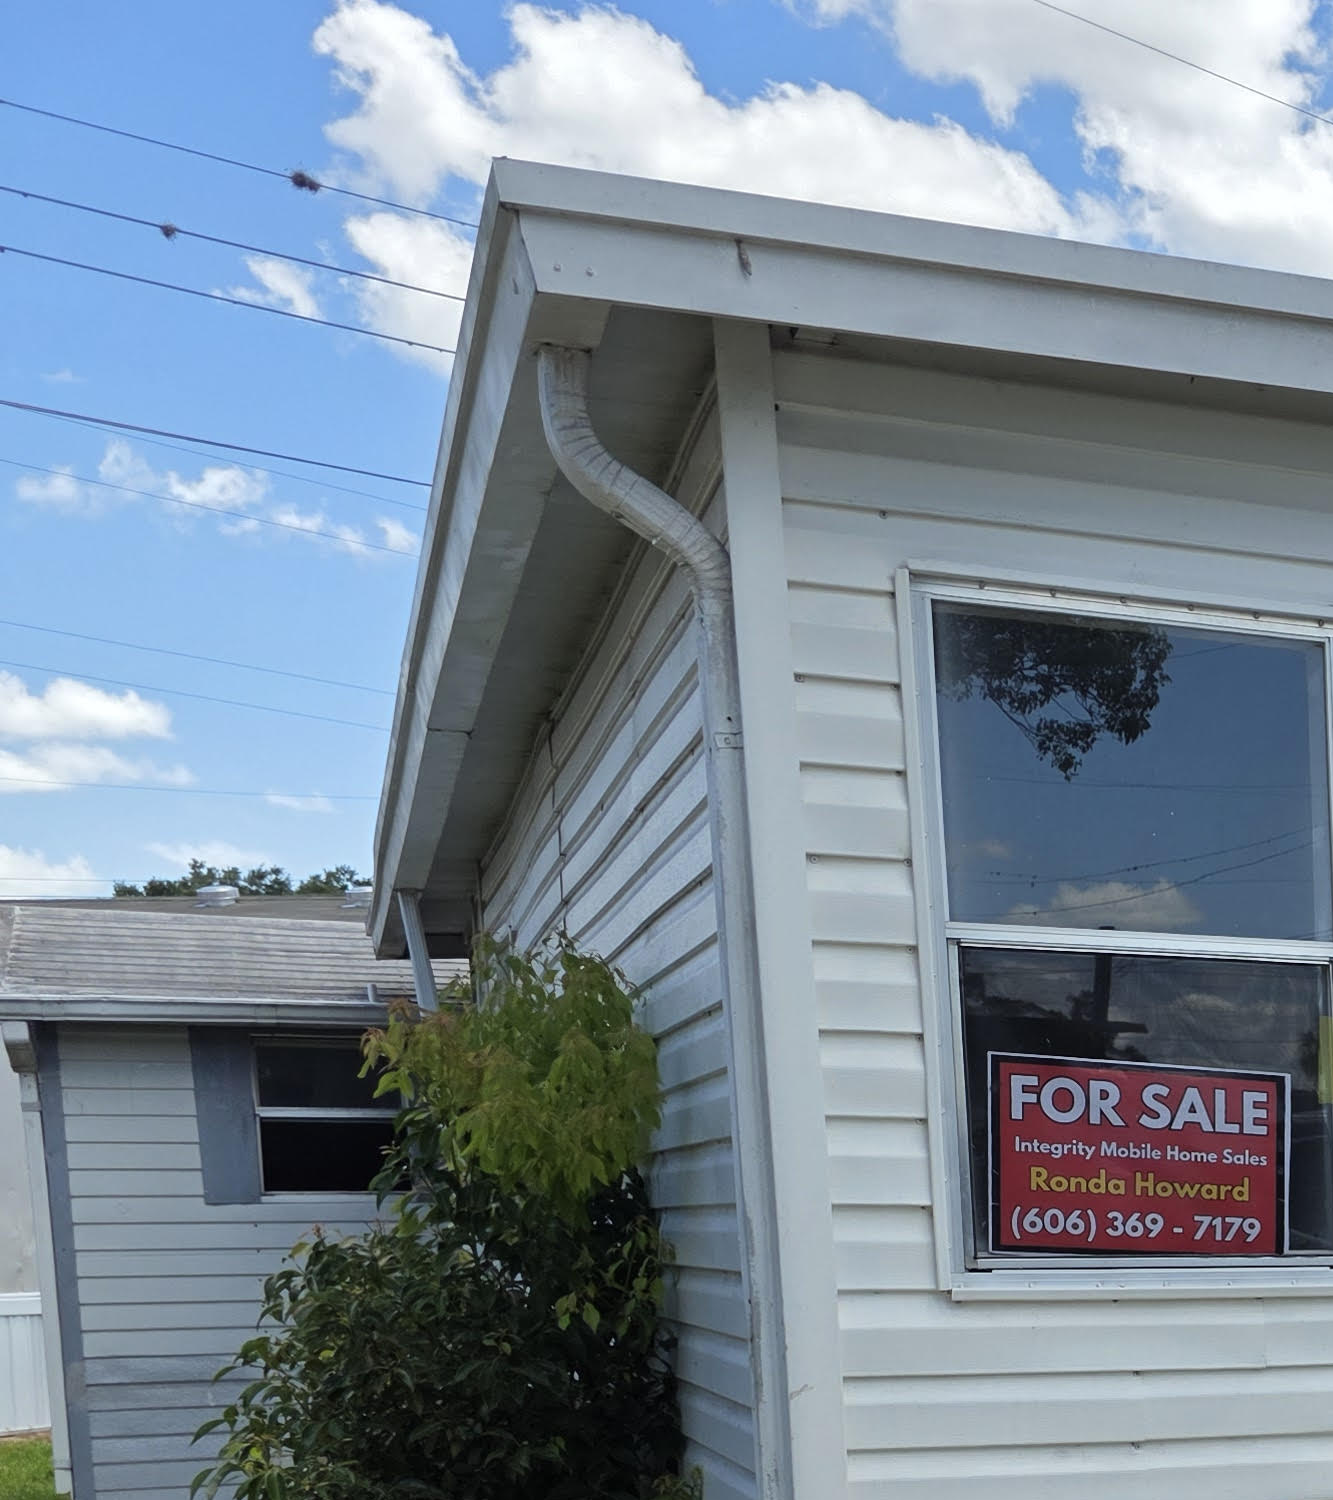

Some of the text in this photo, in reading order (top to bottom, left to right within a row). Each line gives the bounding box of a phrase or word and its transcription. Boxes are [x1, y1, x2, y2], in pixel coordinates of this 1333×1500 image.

[1009, 1073, 1269, 1136] FOR SALE
[1014, 1135, 1268, 1167] Integrity Mobile Home Sales
[1029, 1166, 1250, 1202] Ronda Howard
[1010, 1206, 1097, 1242] (606)
[1105, 1211, 1165, 1239] 369
[1192, 1214, 1262, 1243] 7179
